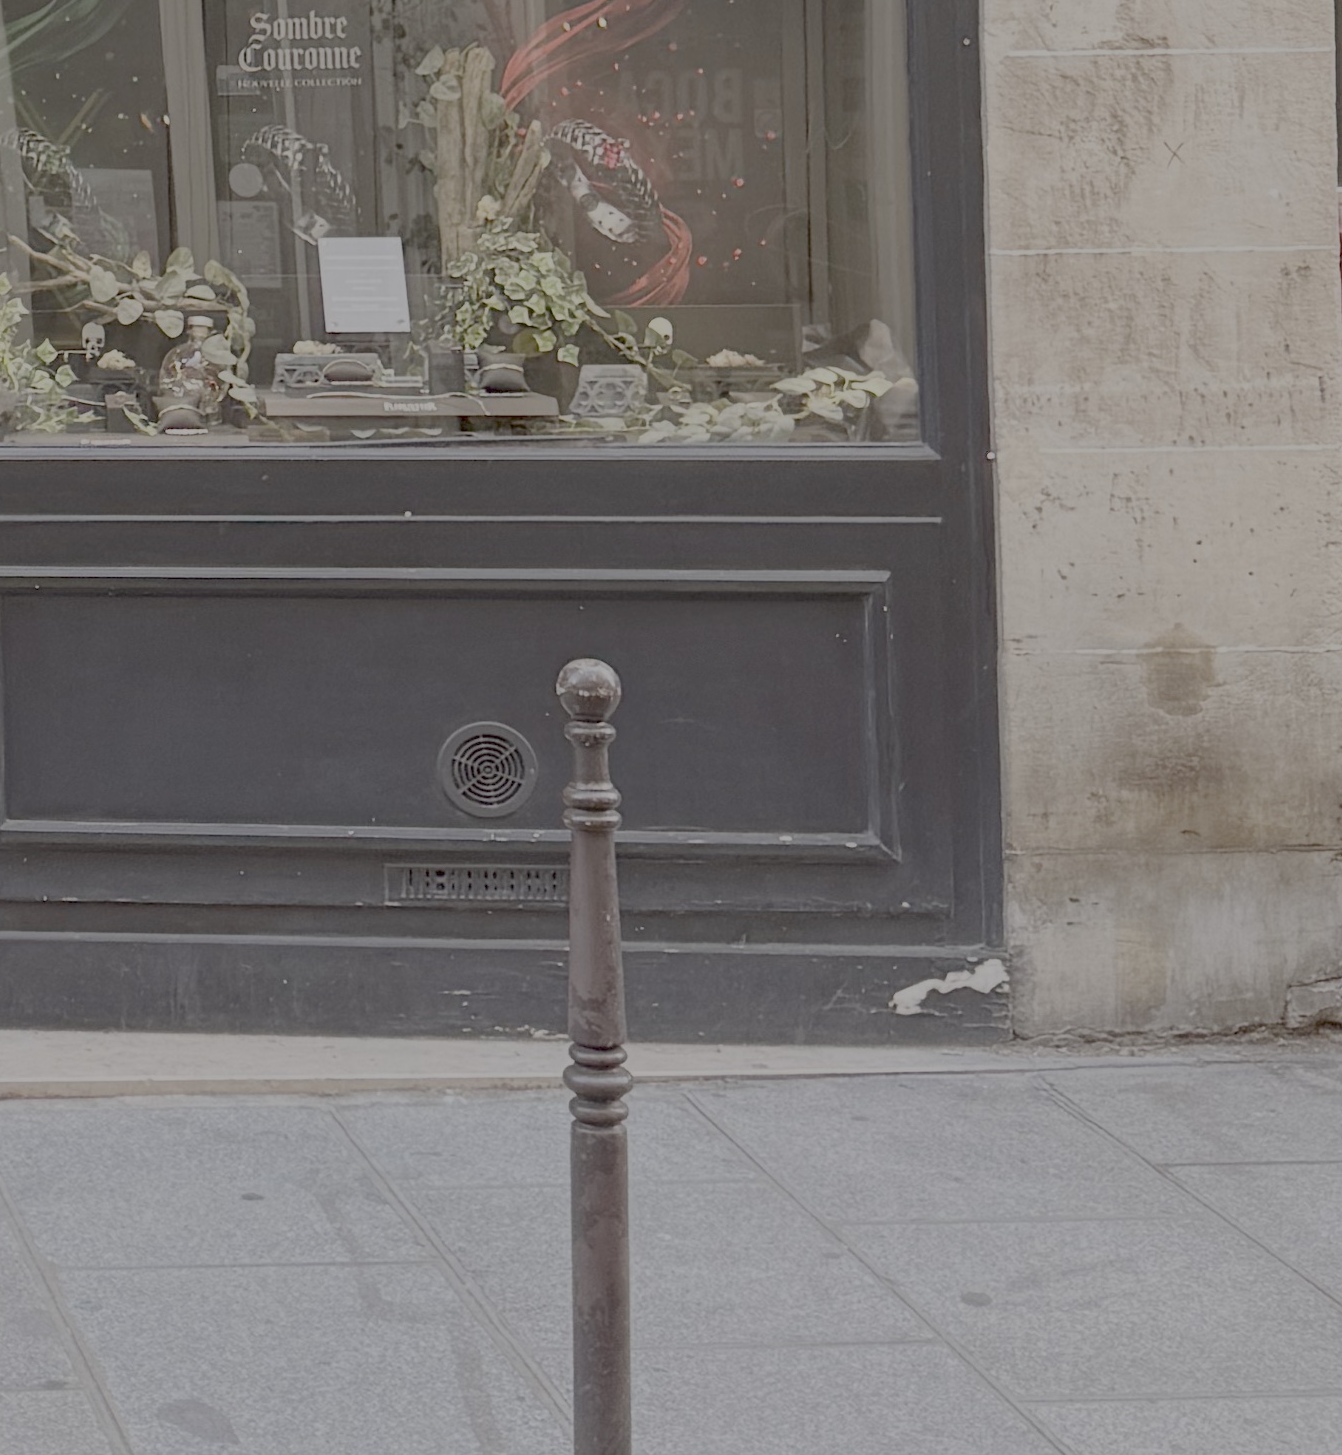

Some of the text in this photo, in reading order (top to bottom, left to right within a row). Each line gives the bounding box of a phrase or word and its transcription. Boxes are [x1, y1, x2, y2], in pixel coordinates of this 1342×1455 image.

[248, 9, 348, 49] Sombre
[237, 44, 362, 73] Couronne
[294, 77, 363, 88] COLLECTION
